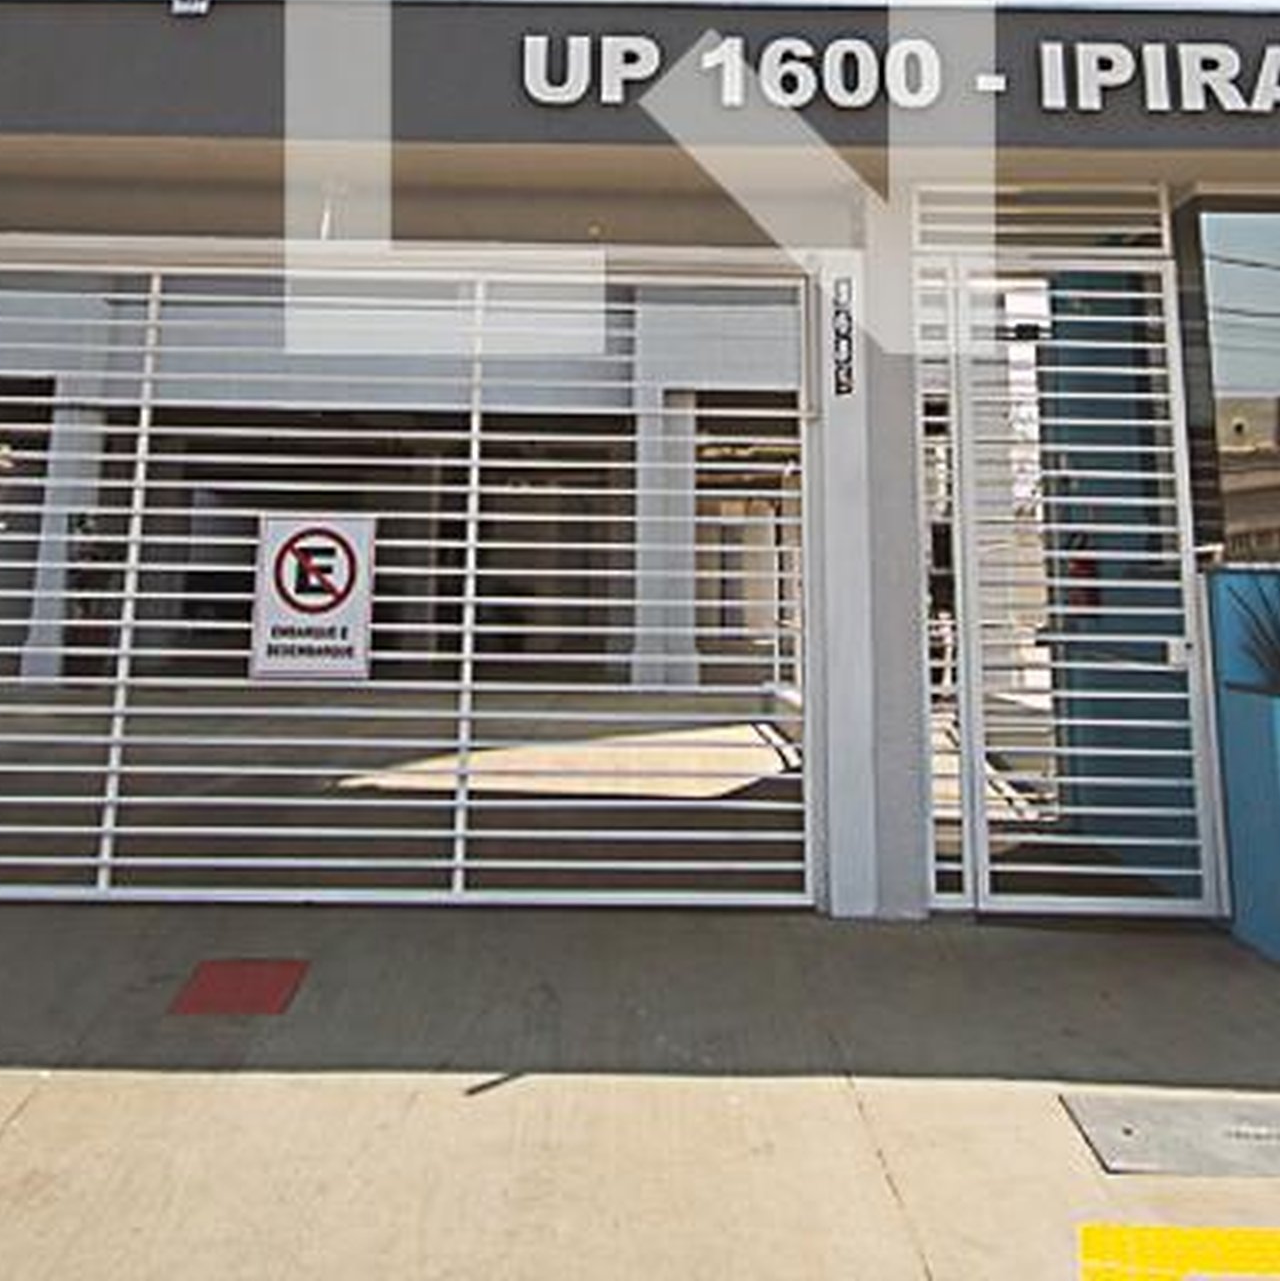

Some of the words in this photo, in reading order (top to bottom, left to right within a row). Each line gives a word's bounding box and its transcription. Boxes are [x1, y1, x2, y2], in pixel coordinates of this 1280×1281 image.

[523, 35, 660, 104] UP
[701, 37, 942, 109] 1600
[975, 73, 1006, 93] -
[271, 625, 336, 640] EMBARQUE
[266, 643, 354, 659] DESEMBARQUE
